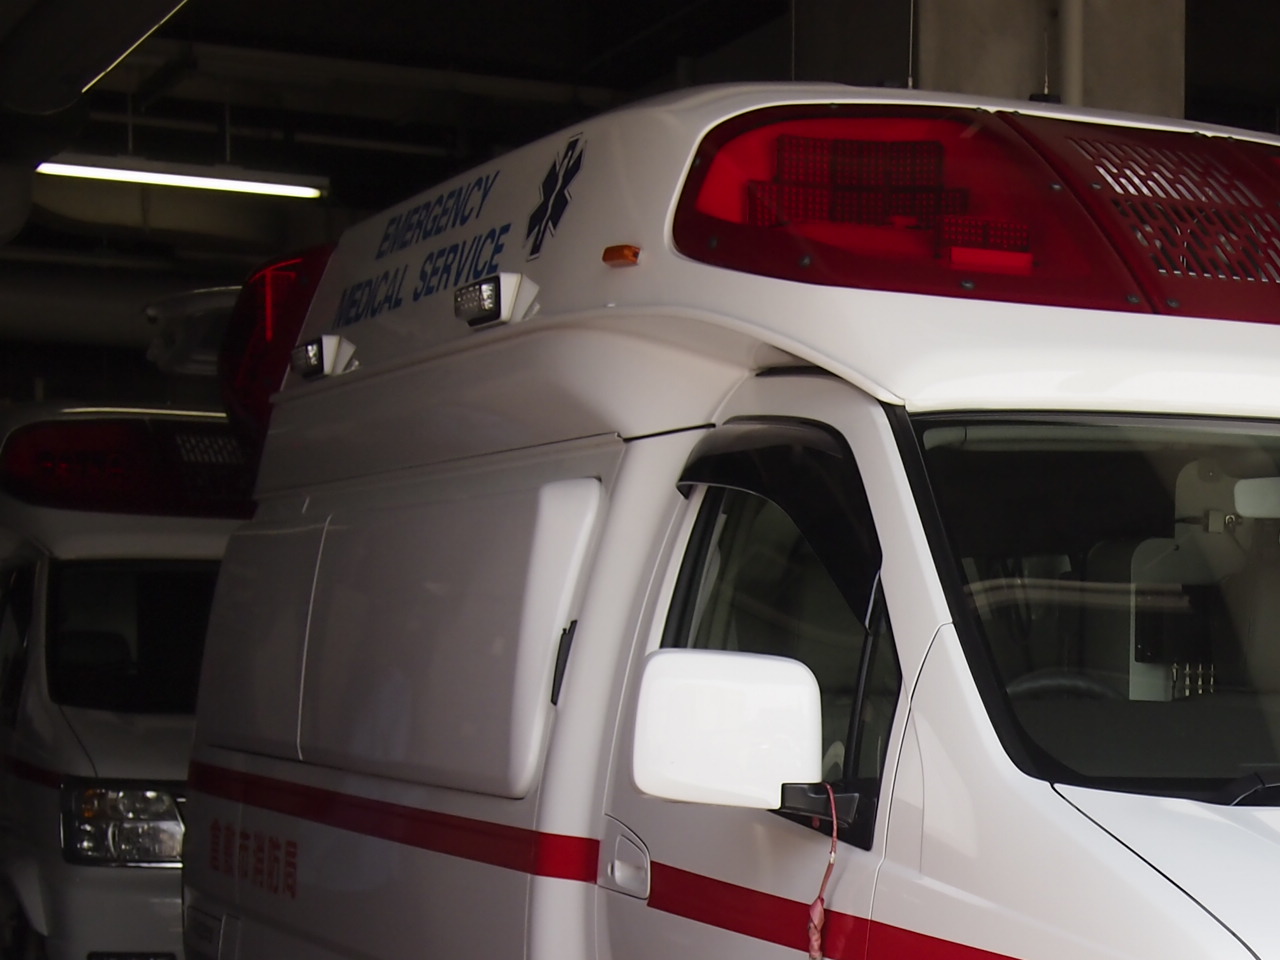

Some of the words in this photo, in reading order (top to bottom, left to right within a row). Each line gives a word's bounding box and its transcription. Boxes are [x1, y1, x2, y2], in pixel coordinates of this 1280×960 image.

[375, 170, 500, 260] EMERGENCY
[333, 263, 408, 330] MEDICAL
[413, 223, 511, 302] SERVICE
